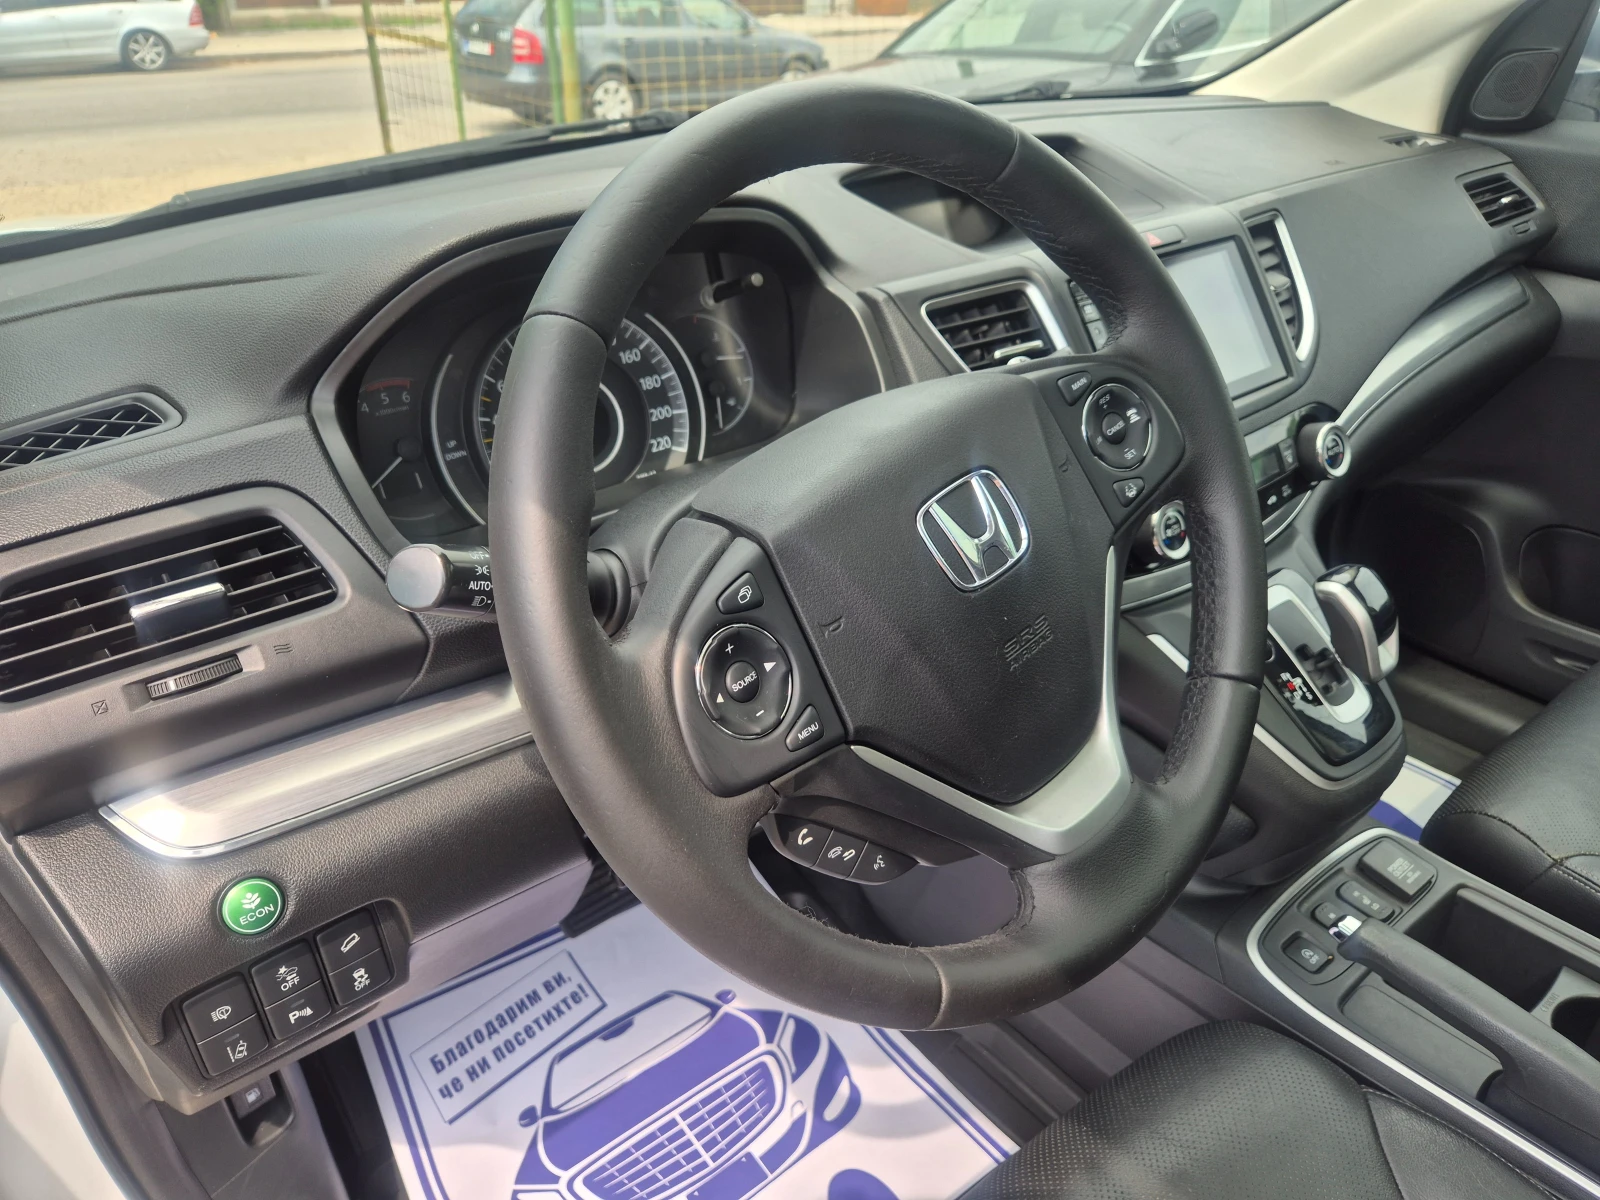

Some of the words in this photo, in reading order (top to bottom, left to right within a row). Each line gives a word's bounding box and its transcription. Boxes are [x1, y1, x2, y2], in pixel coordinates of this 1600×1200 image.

[618, 347, 641, 364] 160
[639, 374, 662, 391] 180
[1071, 376, 1088, 391] MAIN
[380, 392, 390, 405] 5
[402, 391, 411, 403] 6
[1098, 393, 1111, 406] RES
[361, 402, 370, 413] 4
[650, 405, 673, 422] 200
[446, 440, 457, 449] UP
[650, 435, 672, 453] 220
[445, 449, 468, 461] DOWN
[1124, 449, 1137, 460] SET
[468, 580, 491, 591] AUTO
[1004, 614, 1048, 658] SRS
[731, 670, 758, 692] SOURCE
[797, 721, 819, 742] MENU
[239, 903, 275, 926] ECON
[280, 976, 300, 992] OFF
[354, 978, 371, 992] OFF
[429, 988, 543, 1075] Благодарим
[542, 971, 573, 995] ви,
[437, 1076, 464, 1099] че
[465, 1056, 492, 1082] ни
[492, 983, 590, 1063] посетихте!
